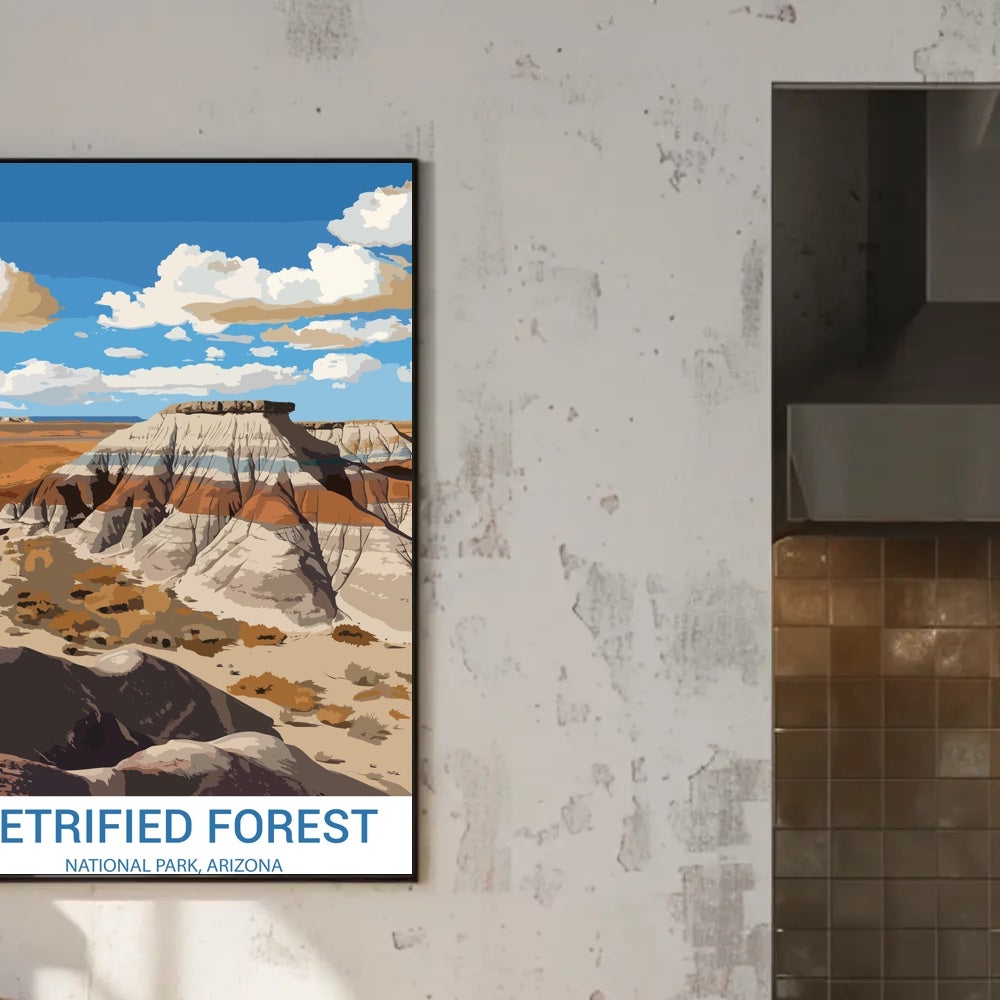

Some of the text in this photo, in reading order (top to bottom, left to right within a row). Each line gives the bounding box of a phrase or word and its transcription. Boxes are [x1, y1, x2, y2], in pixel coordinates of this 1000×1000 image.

[209, 808, 378, 843] FOREST
[65, 858, 283, 875] NATIONAL PARK, ARIZONA
